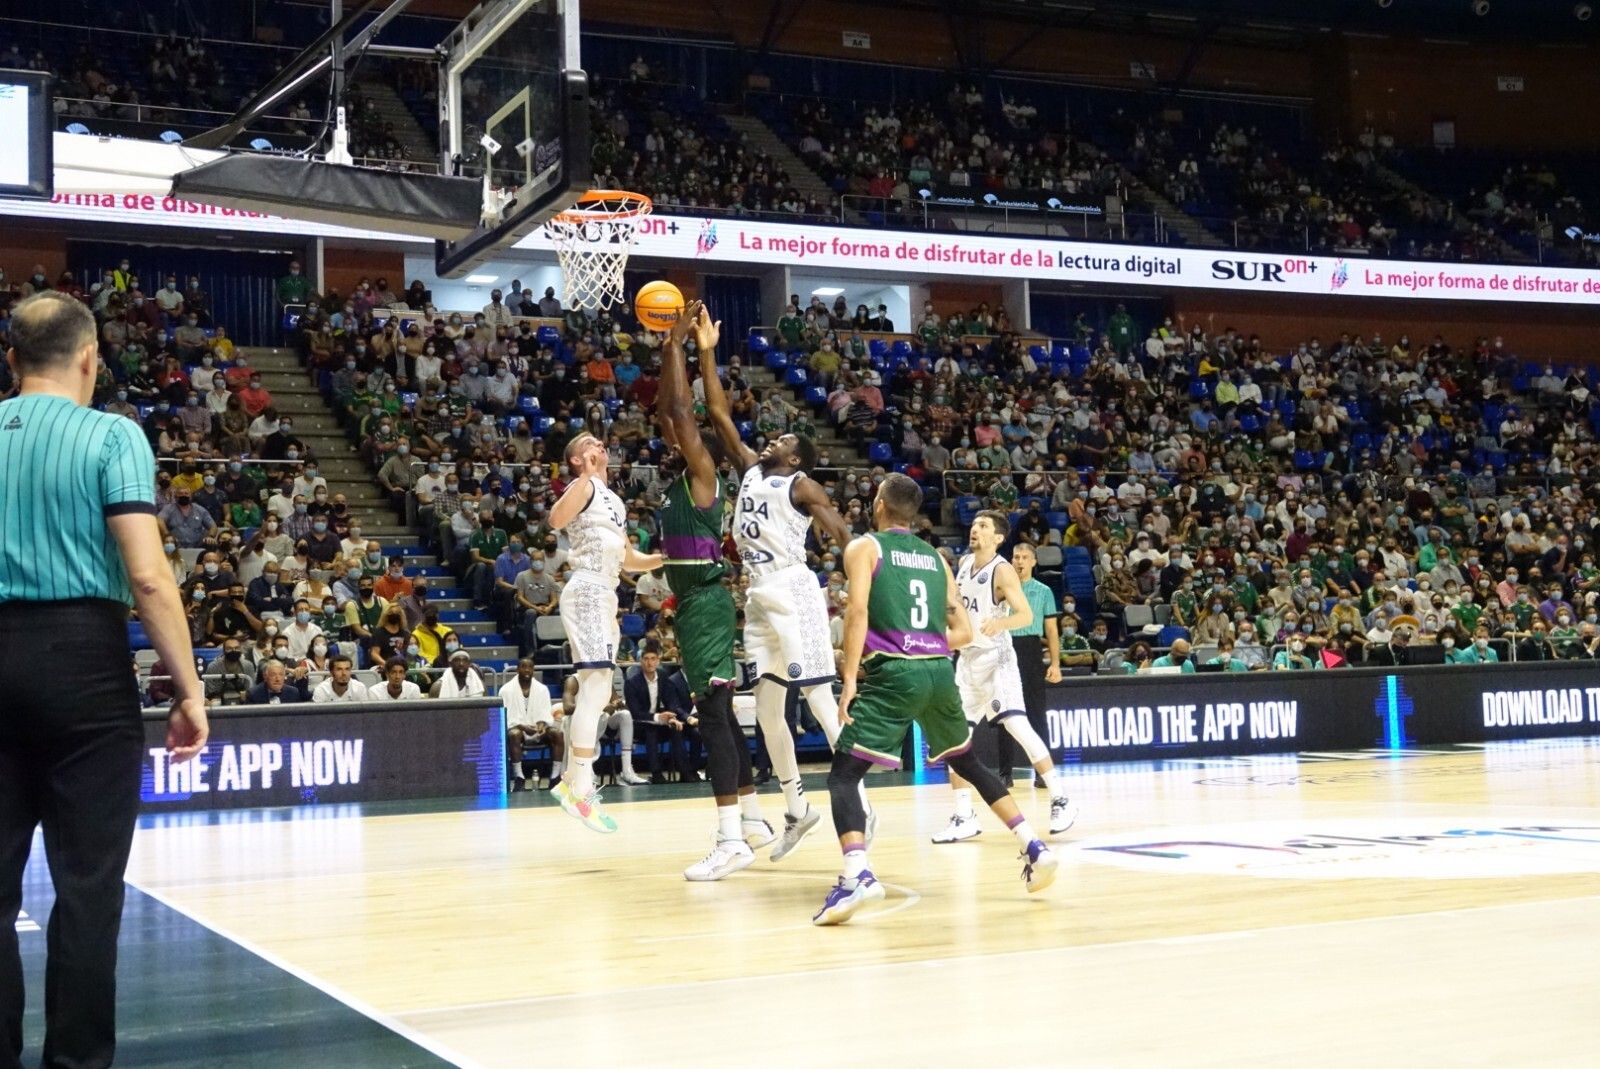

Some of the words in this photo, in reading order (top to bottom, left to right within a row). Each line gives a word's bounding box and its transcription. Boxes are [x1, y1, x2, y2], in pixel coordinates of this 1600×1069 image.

[740, 231, 763, 250] La
[768, 235, 827, 258] mejor
[832, 237, 890, 258] forma
[895, 241, 919, 260] de
[924, 243, 1006, 265] disfrutar
[1010, 248, 1033, 266] de
[1038, 249, 1053, 267] la
[1058, 250, 1120, 271] lectura
[1125, 254, 1181, 277] digital
[1365, 269, 1383, 285] La
[1387, 270, 1434, 291] mejor
[1438, 272, 1485, 289] forma
[1489, 274, 1509, 290] de
[1512, 275, 1579, 293] disfrutar
[1582, 277, 1600, 293] de
[909, 579, 929, 629] 3
[1157, 704, 1198, 743] THE
[1203, 702, 1245, 741] APP
[1250, 700, 1297, 739] NOW
[1482, 688, 1583, 727] DOWNLOAD
[149, 746, 210, 794] THE
[217, 743, 283, 791] APP
[291, 738, 364, 787] NOW
